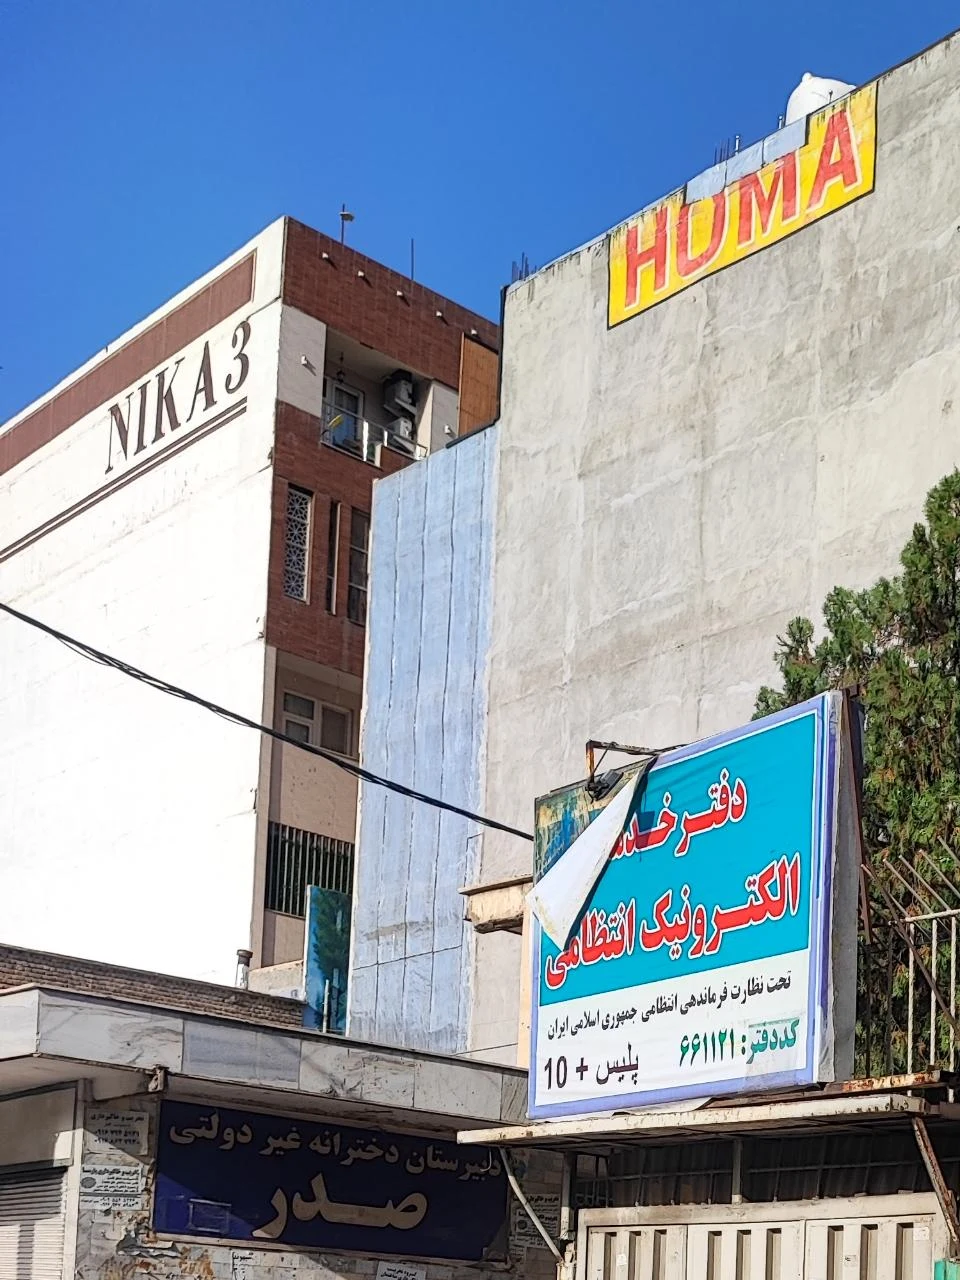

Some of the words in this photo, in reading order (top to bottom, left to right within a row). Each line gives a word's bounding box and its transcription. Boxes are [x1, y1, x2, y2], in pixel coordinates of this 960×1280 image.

[674, 768, 748, 857] دفتر
[640, 852, 801, 961] الکترونیک
[545, 898, 636, 990] انتظامی
[679, 981, 728, 1016] فرماندهی
[730, 975, 764, 1005] نظارت
[766, 970, 792, 994] تحت
[570, 1008, 600, 1036] اسلامی
[601, 1006, 638, 1031] جمهوری
[641, 992, 678, 1022] انتظامی
[547, 1015, 569, 1040] ایران
[596, 1041, 639, 1085] پلیس
[679, 1027, 735, 1067] ۶۶۱۱۲۱
[544, 1055, 568, 1090] 10
[169, 1109, 253, 1151] دولتی
[259, 1125, 302, 1155] غیر
[308, 1131, 399, 1165] دخترانه
[404, 1146, 501, 1182] دبیرستان
[252, 1172, 429, 1239] صدر
